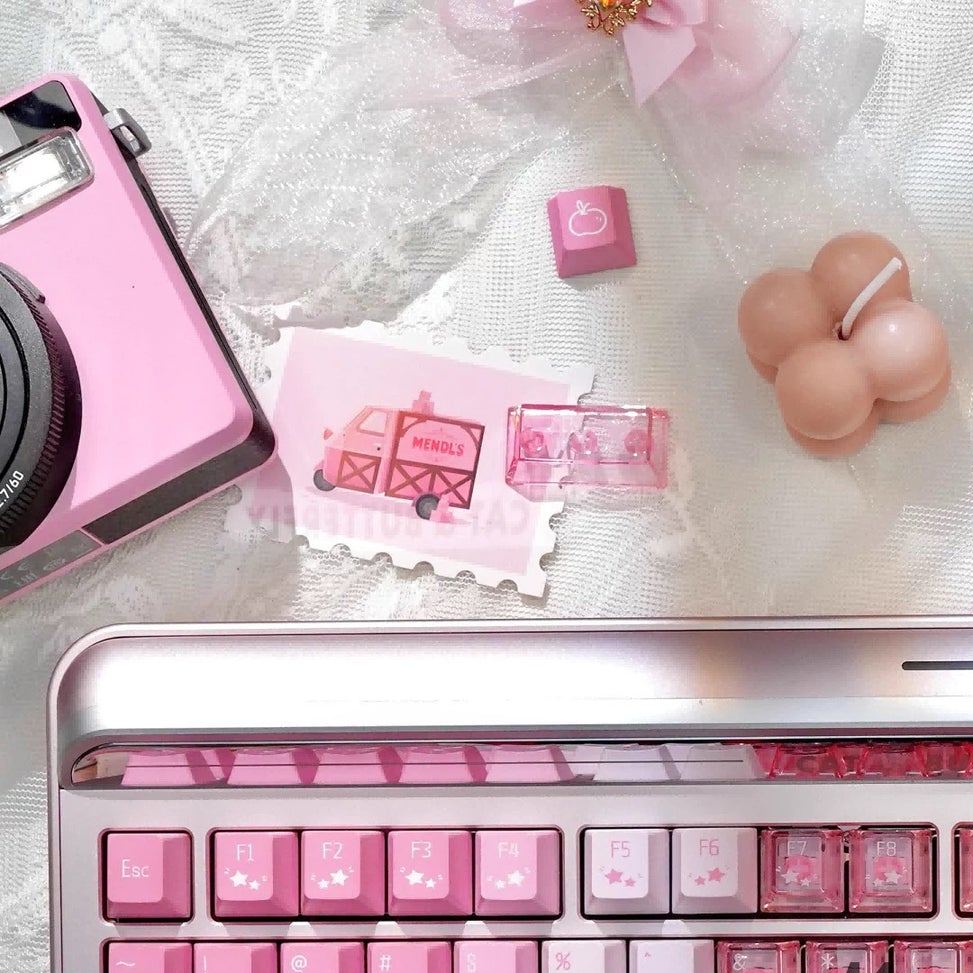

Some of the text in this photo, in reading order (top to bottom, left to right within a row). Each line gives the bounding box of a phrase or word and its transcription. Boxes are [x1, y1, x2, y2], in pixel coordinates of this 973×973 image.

[412, 436, 465, 457] MENDL'S
[236, 843, 254, 862] F1
[322, 842, 343, 860] F2
[411, 841, 432, 859] F3
[498, 842, 520, 859] F4
[610, 840, 631, 858] F5
[700, 839, 720, 856] F6
[787, 841, 807, 856] F7
[877, 841, 896, 856] F8
[121, 859, 149, 878] Esc
[291, 955, 307, 973] @
[379, 954, 392, 972] #
[555, 952, 571, 970] %
[733, 953, 747, 970] &
